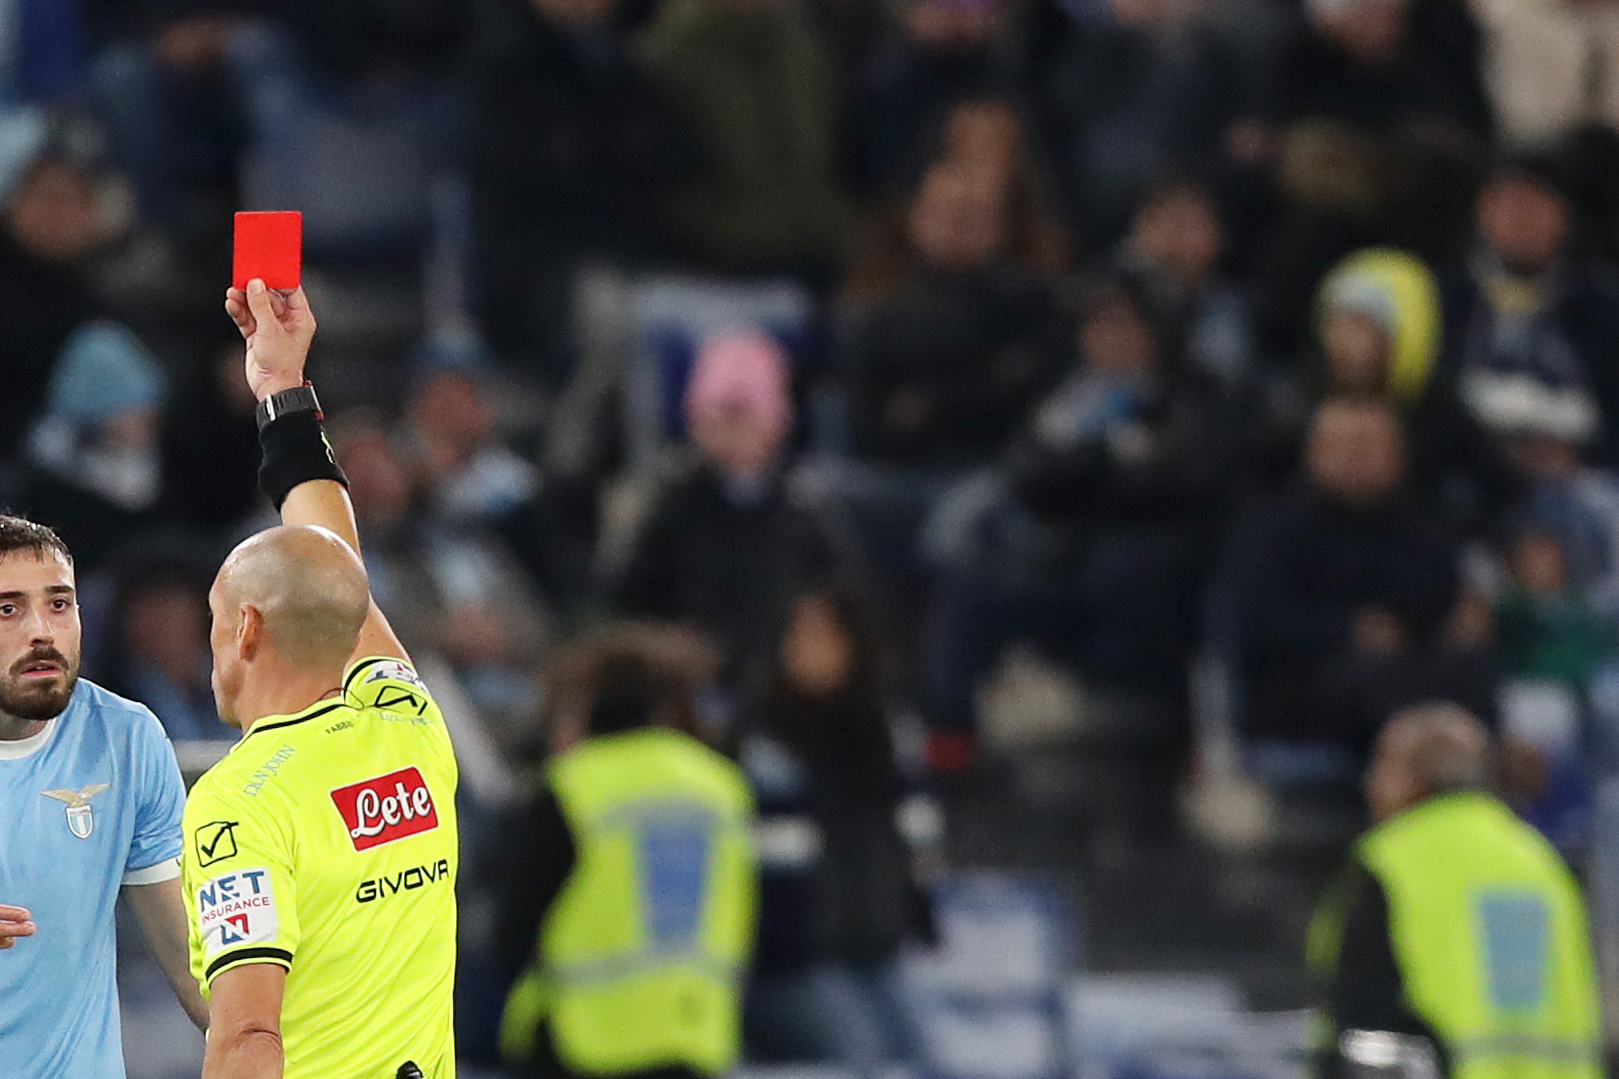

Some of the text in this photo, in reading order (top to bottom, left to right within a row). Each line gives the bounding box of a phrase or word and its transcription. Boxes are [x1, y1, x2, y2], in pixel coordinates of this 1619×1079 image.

[263, 744, 295, 777] JOHN
[350, 782, 431, 838] Lete
[200, 871, 264, 913] NET
[356, 859, 449, 904] GIVOVA
